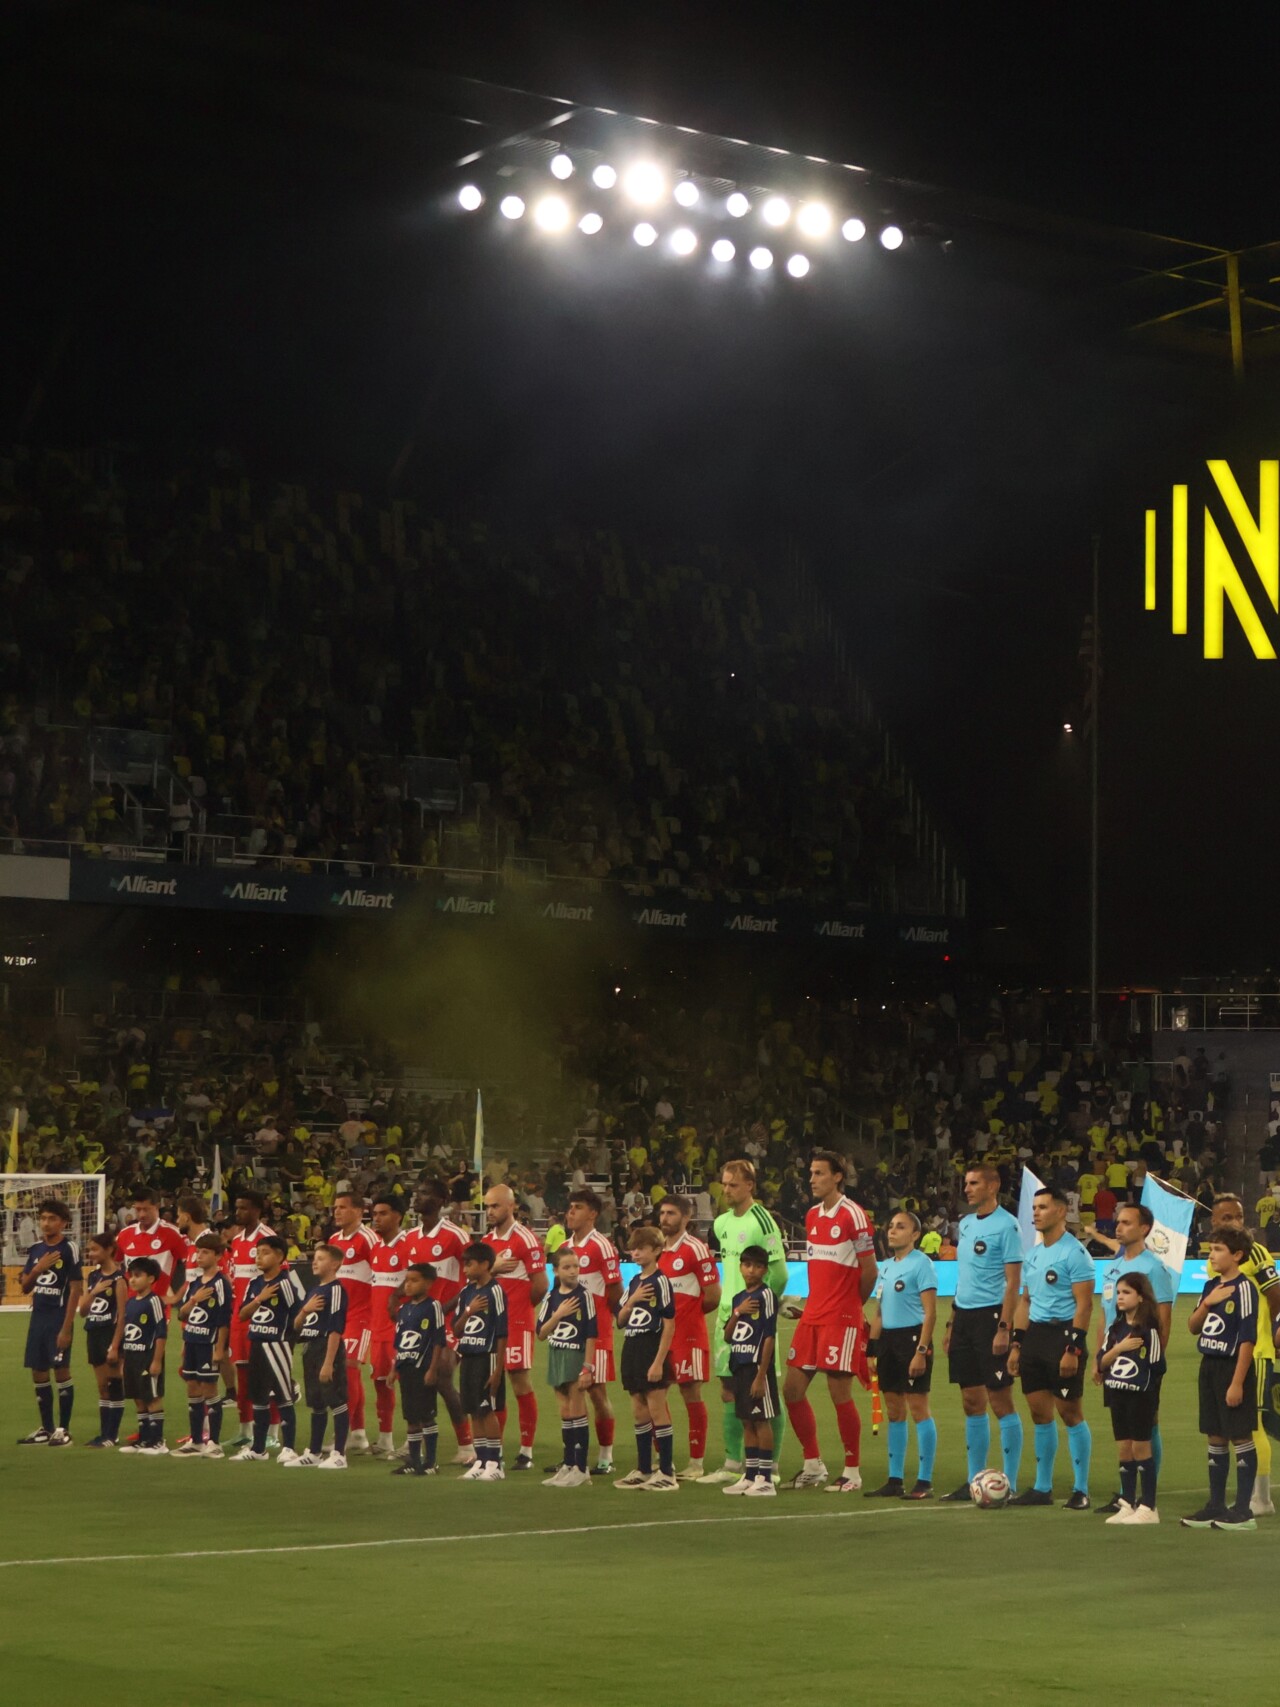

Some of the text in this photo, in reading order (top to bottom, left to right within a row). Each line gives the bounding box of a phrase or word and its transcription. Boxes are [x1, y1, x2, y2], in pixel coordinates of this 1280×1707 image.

[117, 875, 177, 895] Alliant
[229, 882, 288, 902] Alliant
[338, 889, 394, 909] Alliant
[442, 896, 496, 915] Alliant
[541, 902, 594, 921] Alliant
[638, 908, 688, 928] Alliant
[729, 915, 779, 934] Alliant
[820, 920, 866, 938] Alliant
[904, 926, 950, 943] Alliant
[1262, 1204, 1273, 1213] 20
[1266, 1267, 1276, 1280] C
[506, 1346, 523, 1364] 15
[825, 1346, 839, 1364] 3
